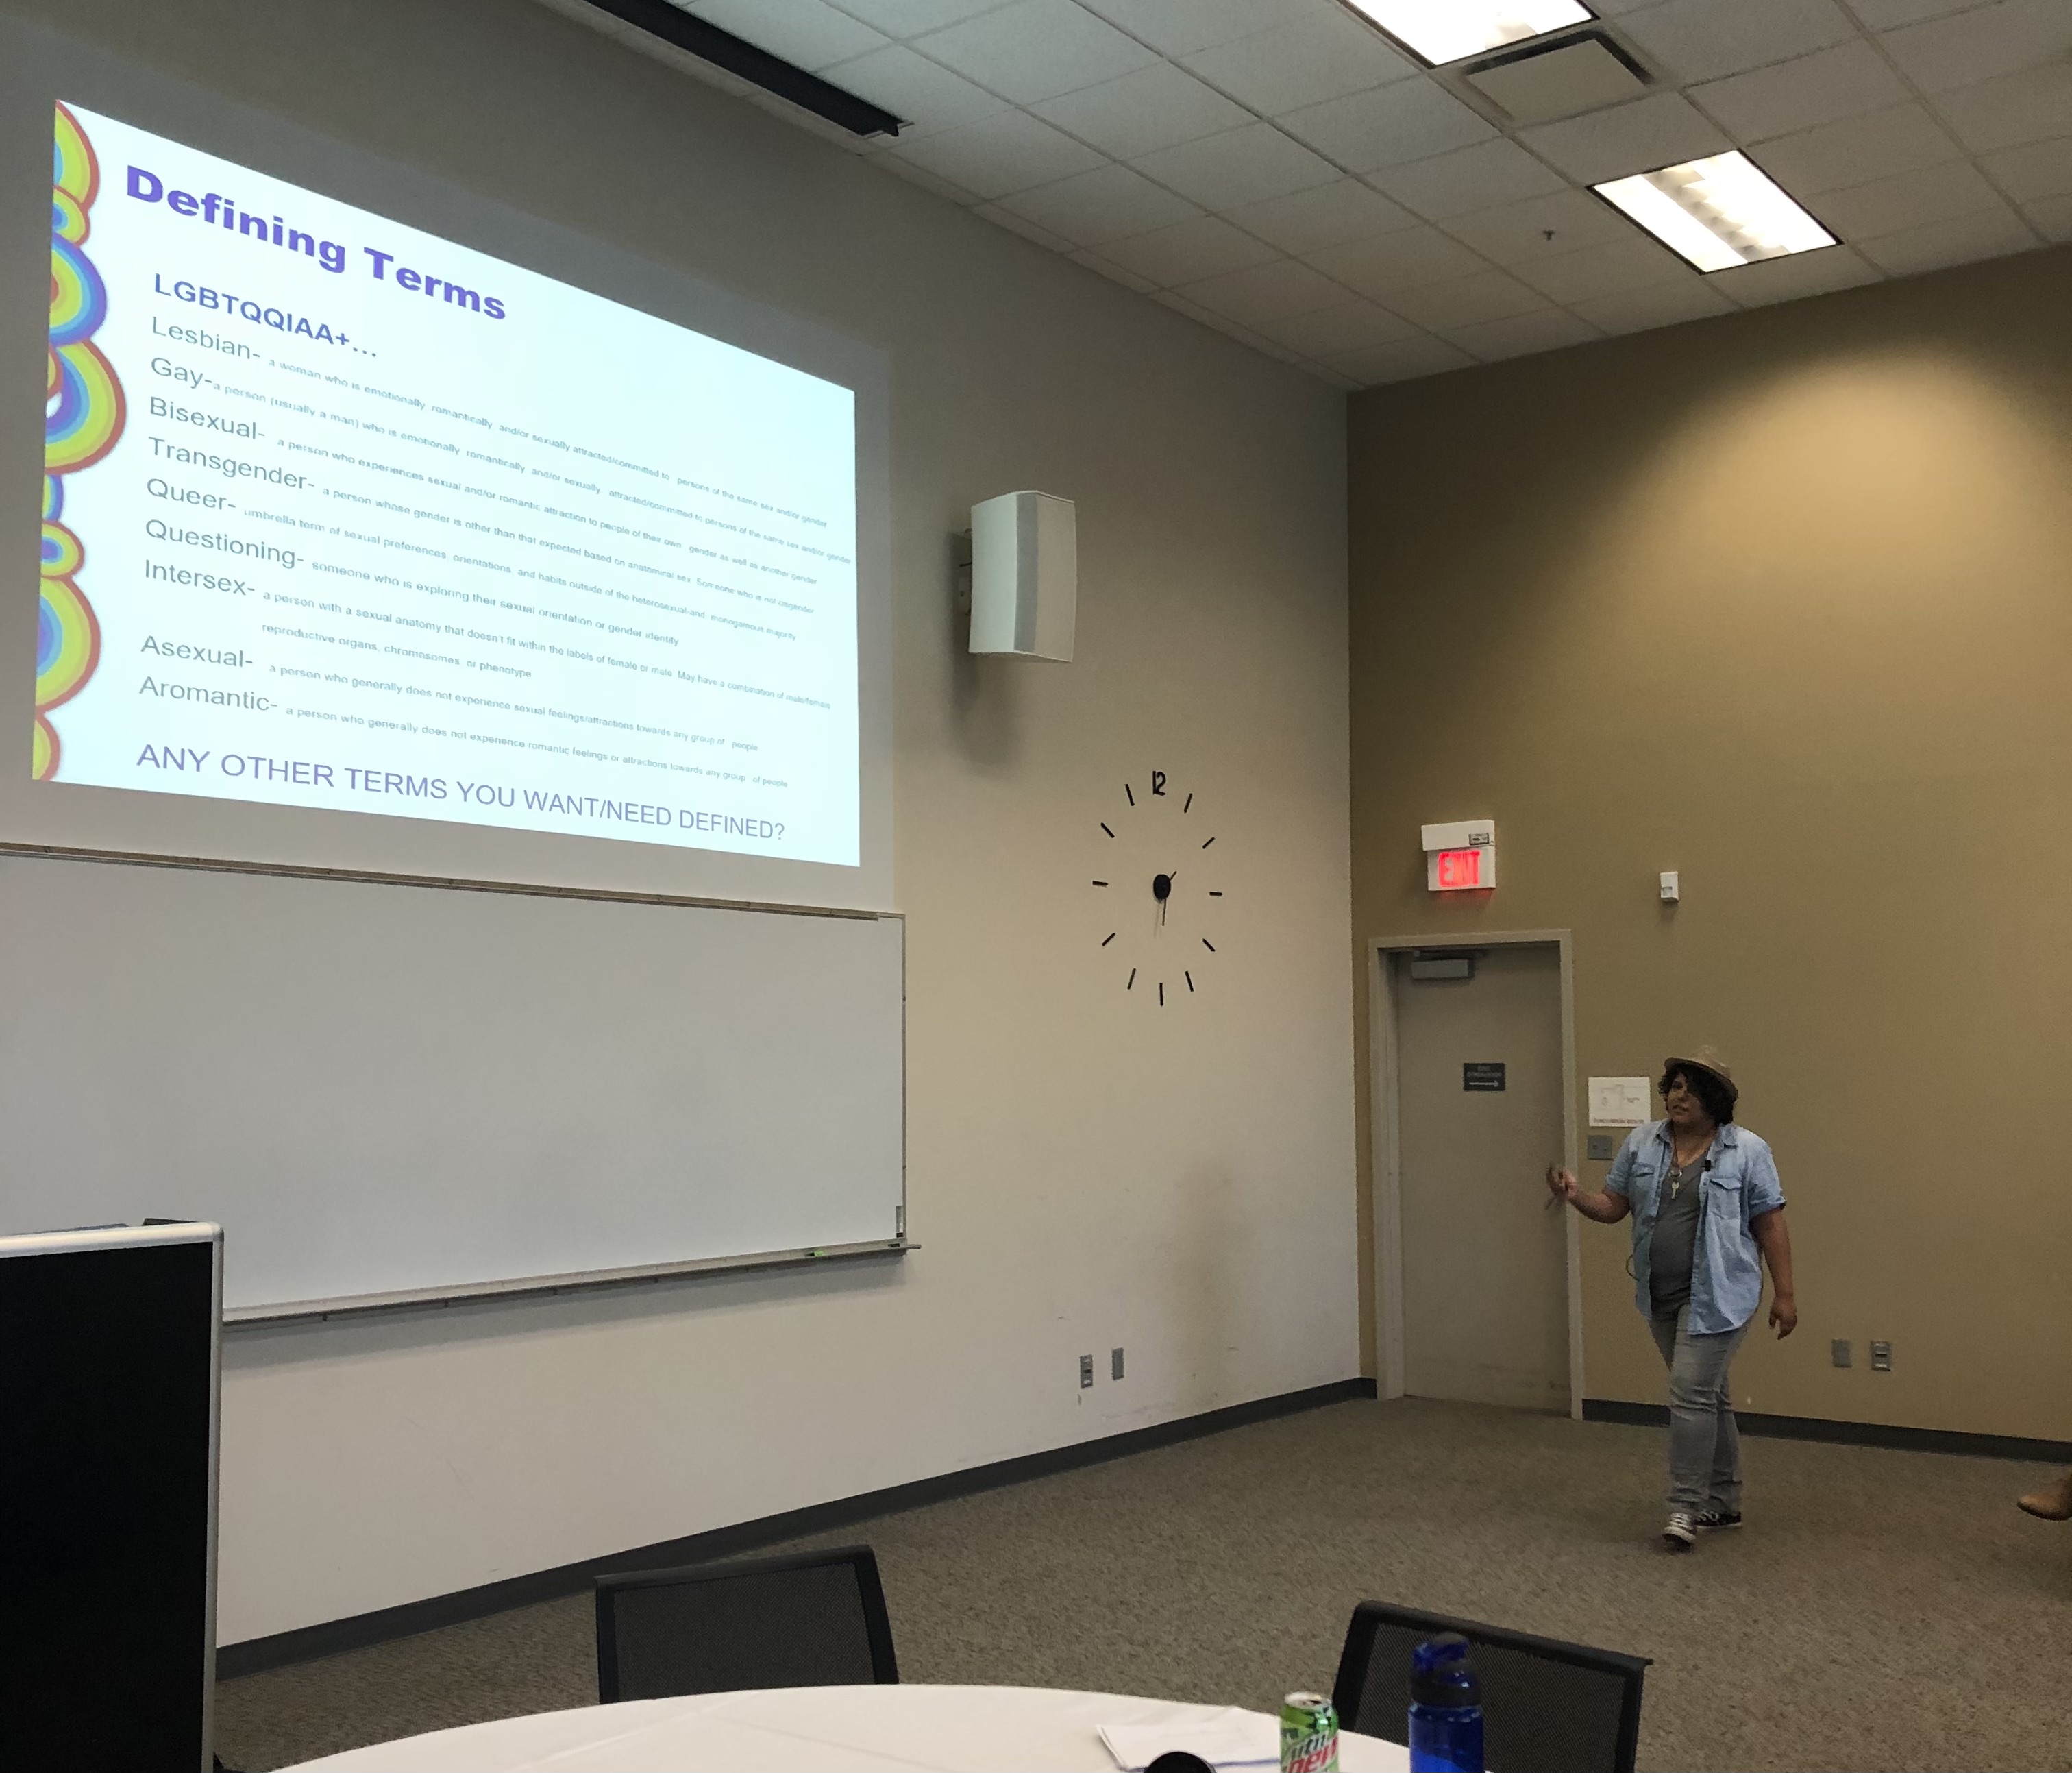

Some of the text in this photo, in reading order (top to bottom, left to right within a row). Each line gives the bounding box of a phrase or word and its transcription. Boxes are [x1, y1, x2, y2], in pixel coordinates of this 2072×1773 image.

[126, 164, 506, 319] Defining Terms
[154, 273, 376, 357] LGBTQQIAA+...
[152, 316, 260, 359] Lesbian-
[279, 363, 321, 379] woman
[325, 375, 347, 387] who
[498, 424, 528, 437] and/or
[150, 395, 264, 439] Bisexual-
[288, 441, 328, 456] person
[332, 452, 355, 463] who
[358, 459, 423, 480] experiences
[428, 476, 460, 490] sexual
[464, 486, 495, 498] and/or
[499, 495, 539, 510] romantic
[543, 506, 586, 523] attraction
[224, 386, 265, 402] person
[270, 398, 315, 416] (usually
[330, 414, 358, 428] man)
[362, 422, 384, 434] who
[531, 468, 560, 480] and/or
[147, 478, 236, 510] Queer-
[244, 509, 295, 526] umbrella
[299, 519, 324, 531] term
[344, 530, 380, 543] sexual
[517, 569, 535, 578] and
[538, 572, 567, 586] habits
[148, 436, 314, 489] Transgender-
[333, 490, 371, 504] person
[375, 500, 410, 514] whose
[413, 509, 449, 523] gender
[465, 522, 491, 533] other
[493, 527, 515, 539] than
[518, 533, 536, 543] that
[539, 539, 581, 555] expected
[145, 519, 304, 569] Questioning-
[312, 562, 370, 580] someone
[374, 574, 399, 585] who
[416, 583, 469, 602] exploring
[473, 594, 495, 606] their
[500, 600, 534, 614] sexual
[538, 609, 592, 626] orientation
[145, 559, 254, 596] Intersex-
[262, 591, 270, 600] a
[274, 594, 314, 608] person
[318, 602, 341, 613] with
[356, 609, 391, 622] sexual
[395, 616, 441, 633] anatomy
[444, 624, 464, 636] that
[506, 635, 515, 646] fit
[518, 641, 545, 652] within
[140, 635, 253, 667] Asexual-
[280, 667, 320, 679] person
[324, 673, 348, 683] who
[352, 678, 402, 694] generally
[406, 685, 431, 696] does
[436, 692, 452, 700] not
[454, 694, 510, 709] experience
[514, 704, 545, 715] sexual
[262, 624, 335, 643] reproductive
[480, 662, 531, 678] phenotype
[138, 676, 278, 711] Aromantic-
[297, 709, 336, 720] person
[341, 714, 364, 724] who
[368, 719, 417, 733] generally
[421, 725, 447, 736] does
[451, 731, 466, 739] not
[469, 734, 525, 747] experience
[528, 742, 569, 754] romantic
[136, 744, 785, 840] ANY OTHER TERMS YOU WANT/NEED DEFINED?
[1152, 770, 1166, 796] 12
[1438, 850, 1481, 888] EXIT
